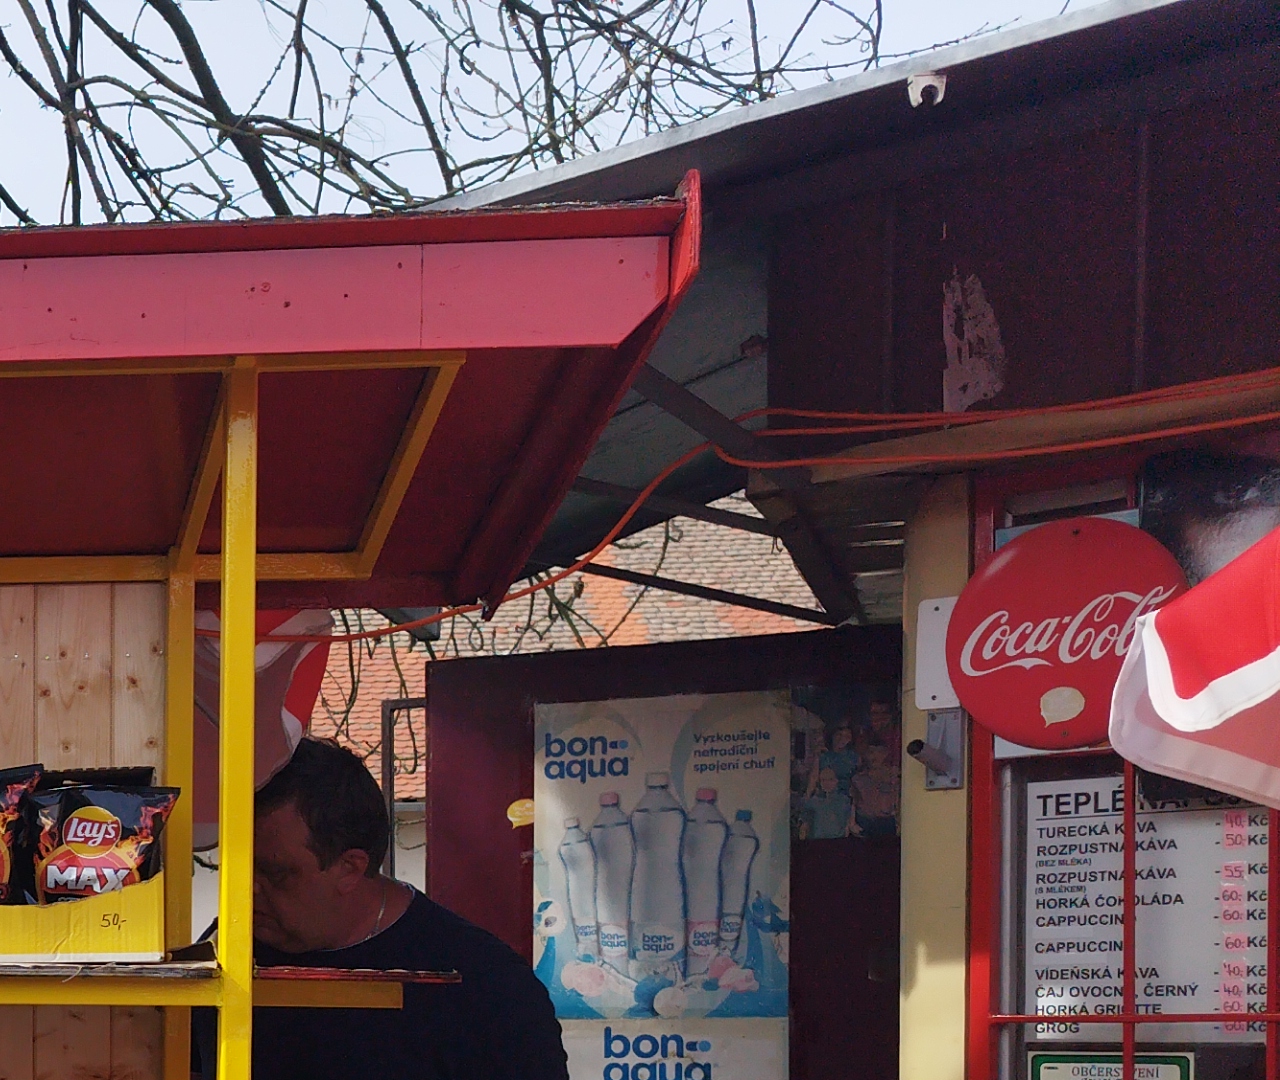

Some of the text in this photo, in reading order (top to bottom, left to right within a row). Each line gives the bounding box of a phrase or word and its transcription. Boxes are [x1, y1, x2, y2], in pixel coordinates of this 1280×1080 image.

[960, 583, 1178, 677] Coca-Col
[544, 755, 630, 784] aqua
[67, 821, 117, 846] Lay's
[1037, 815, 1268, 838] TURECKÁ Kč
[1135, 834, 1268, 851] KÁVA Kč
[47, 865, 130, 895] MAX
[1135, 863, 1268, 880] KÁVA Kč
[1036, 890, 1267, 909] HORKÁ Kč
[1247, 909, 1267, 920] Kč
[1035, 982, 1198, 998] ČAJ ČERNÝ
[1036, 1002, 1089, 1015] HORKÁ
[1035, 1022, 1079, 1033] GROG
